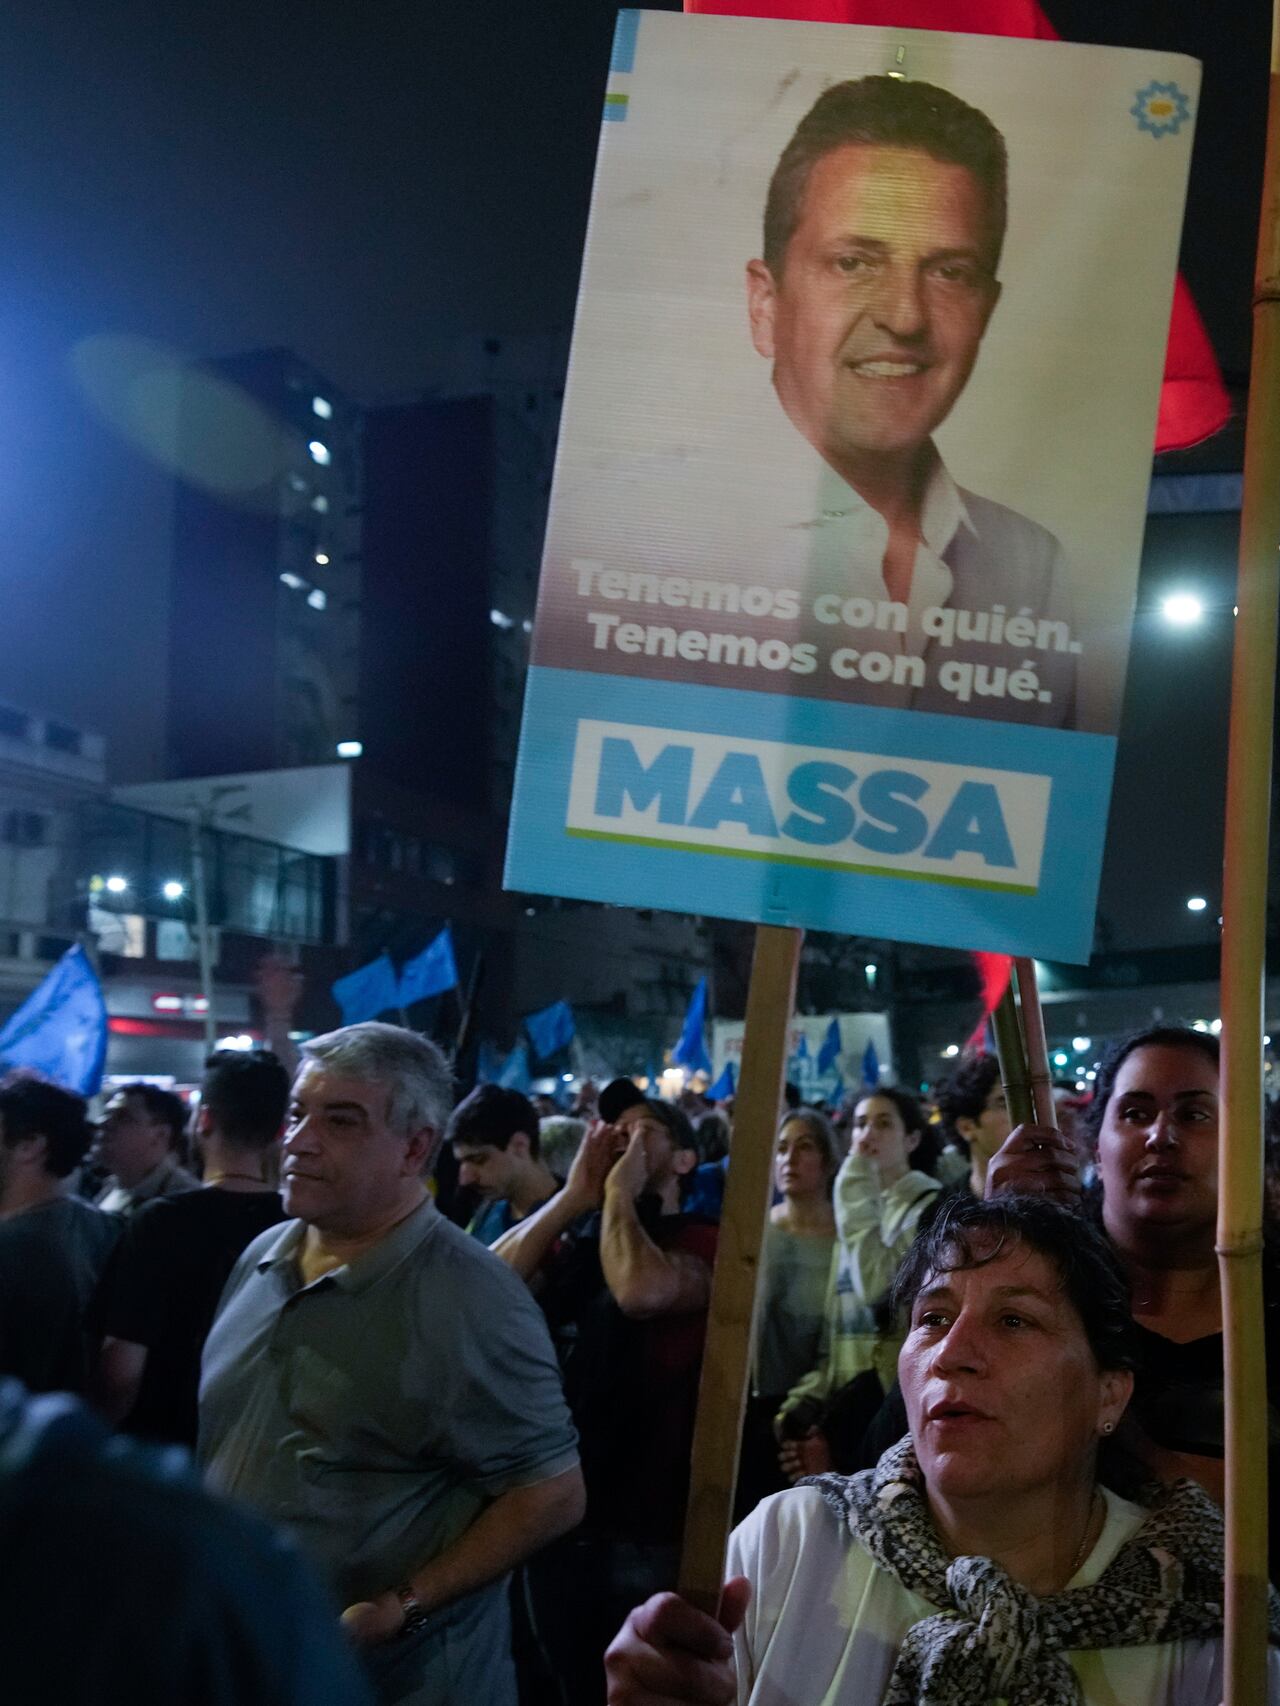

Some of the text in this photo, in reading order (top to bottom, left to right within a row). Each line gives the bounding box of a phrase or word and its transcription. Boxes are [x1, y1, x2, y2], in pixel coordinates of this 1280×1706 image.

[571, 557, 1083, 654] Tenemos con quién.
[587, 612, 1053, 703] Tenemos con qué.
[593, 736, 1018, 870] MASSA
